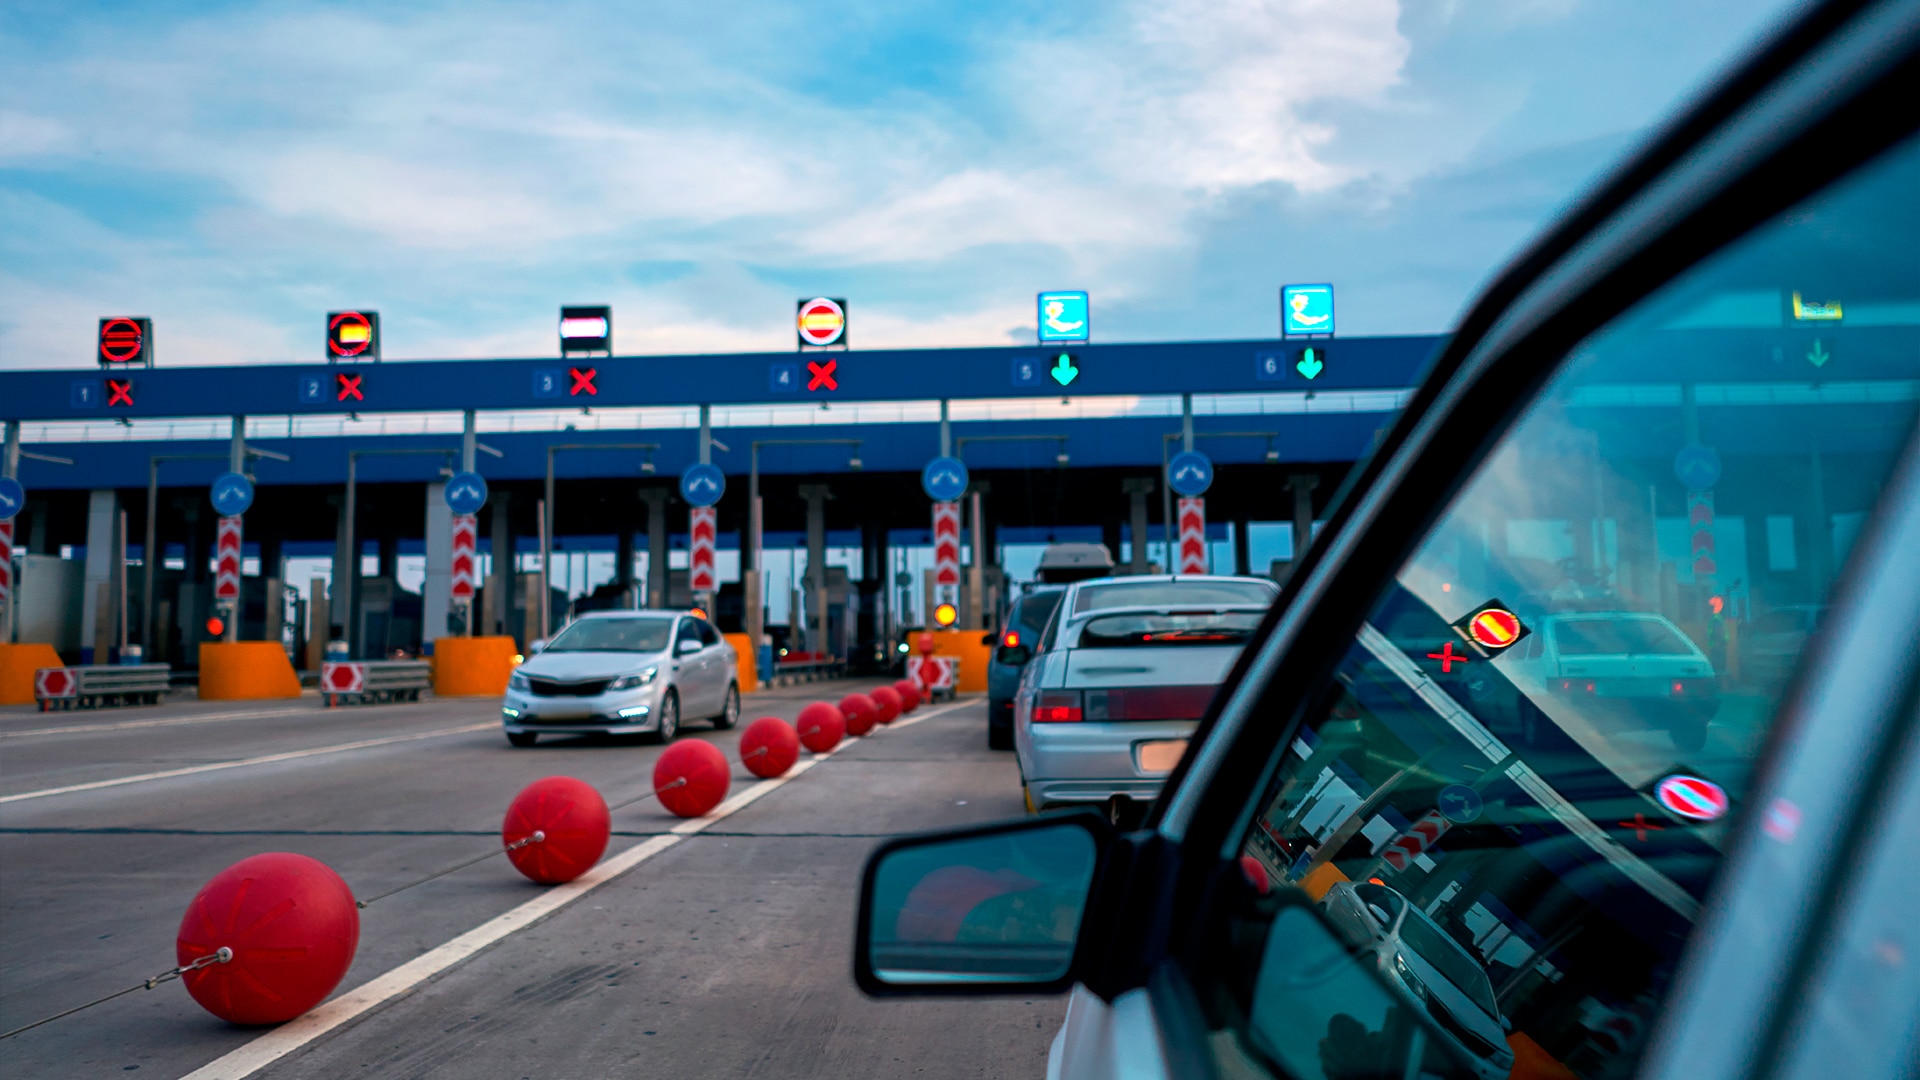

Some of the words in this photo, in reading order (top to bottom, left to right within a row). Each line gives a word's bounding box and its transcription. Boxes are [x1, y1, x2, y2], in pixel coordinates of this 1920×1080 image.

[1021, 364, 1032, 380] 5
[1264, 358, 1277, 375] 6
[779, 371, 789, 385] 4
[308, 380, 319, 398] 2
